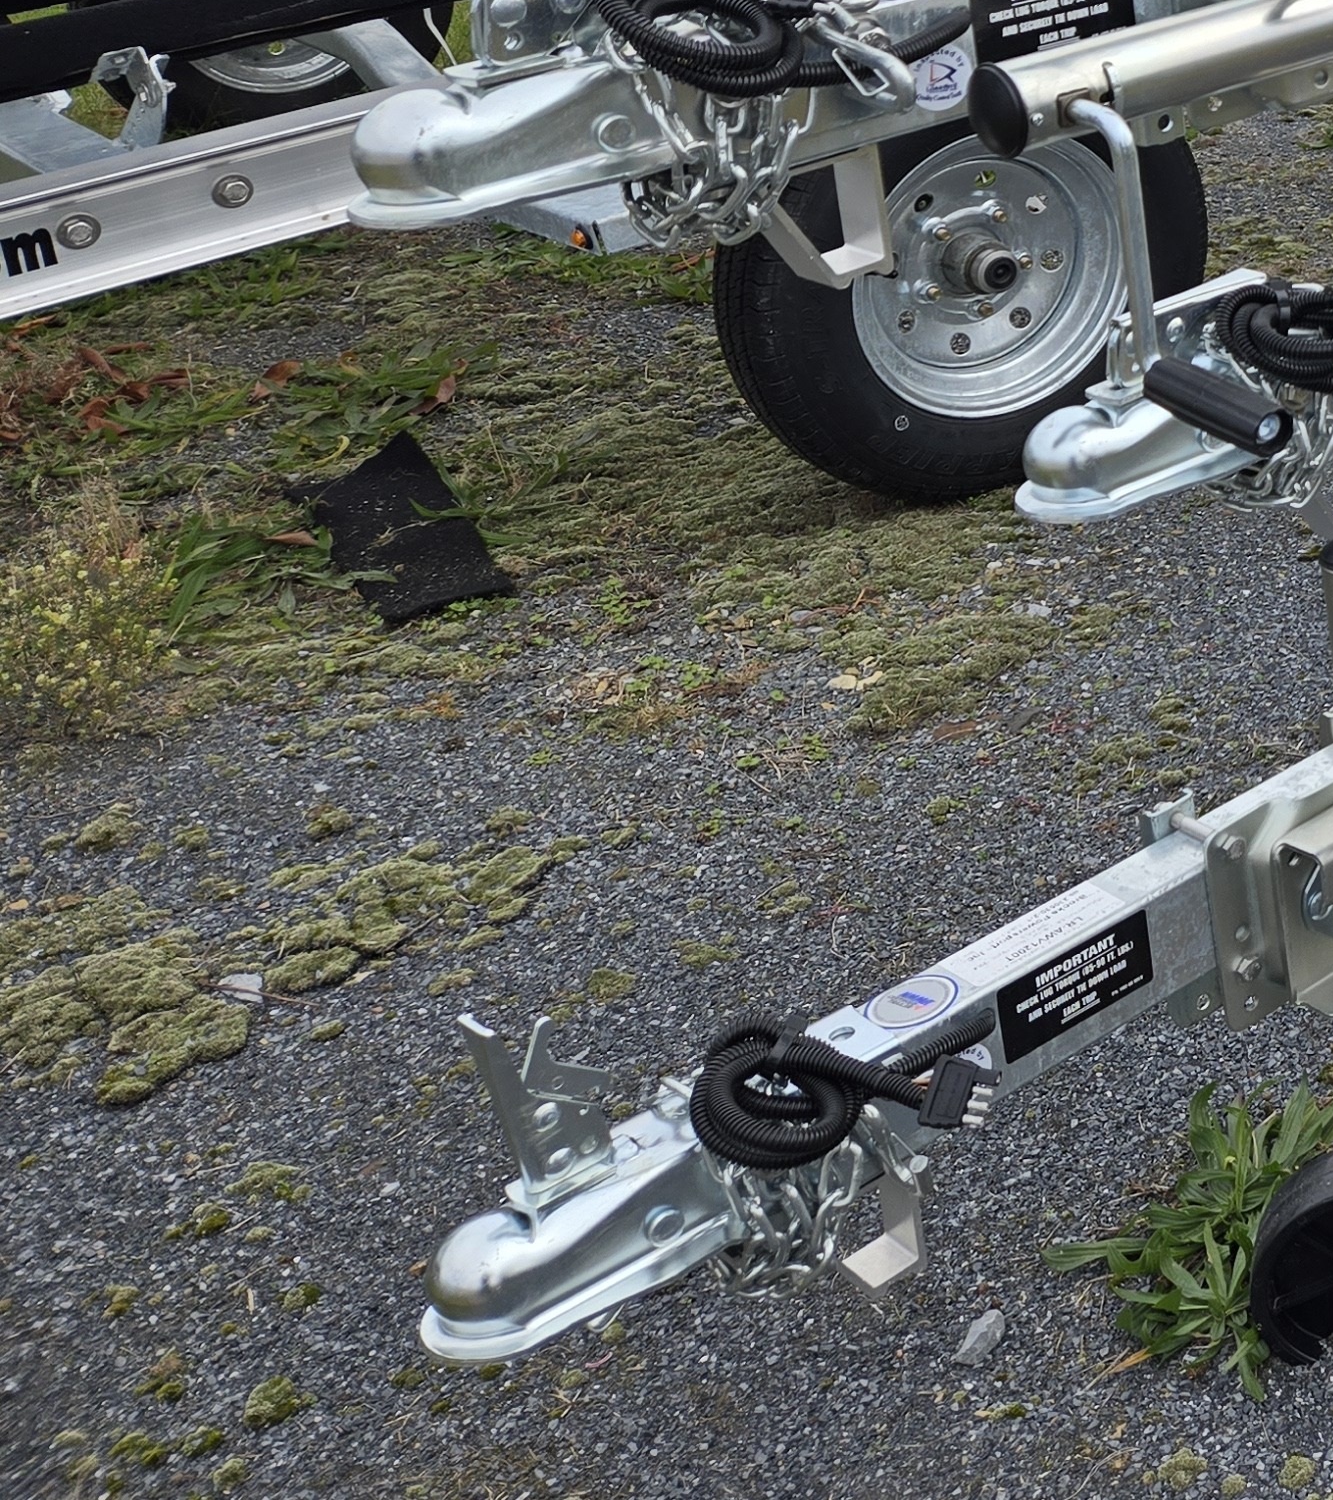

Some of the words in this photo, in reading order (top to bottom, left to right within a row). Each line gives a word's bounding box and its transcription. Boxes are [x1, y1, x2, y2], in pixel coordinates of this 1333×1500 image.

[1035, 934, 1115, 988] IMPORTANT
[1016, 994, 1039, 1013] CHECK
[1055, 971, 1081, 992] TORQUE
